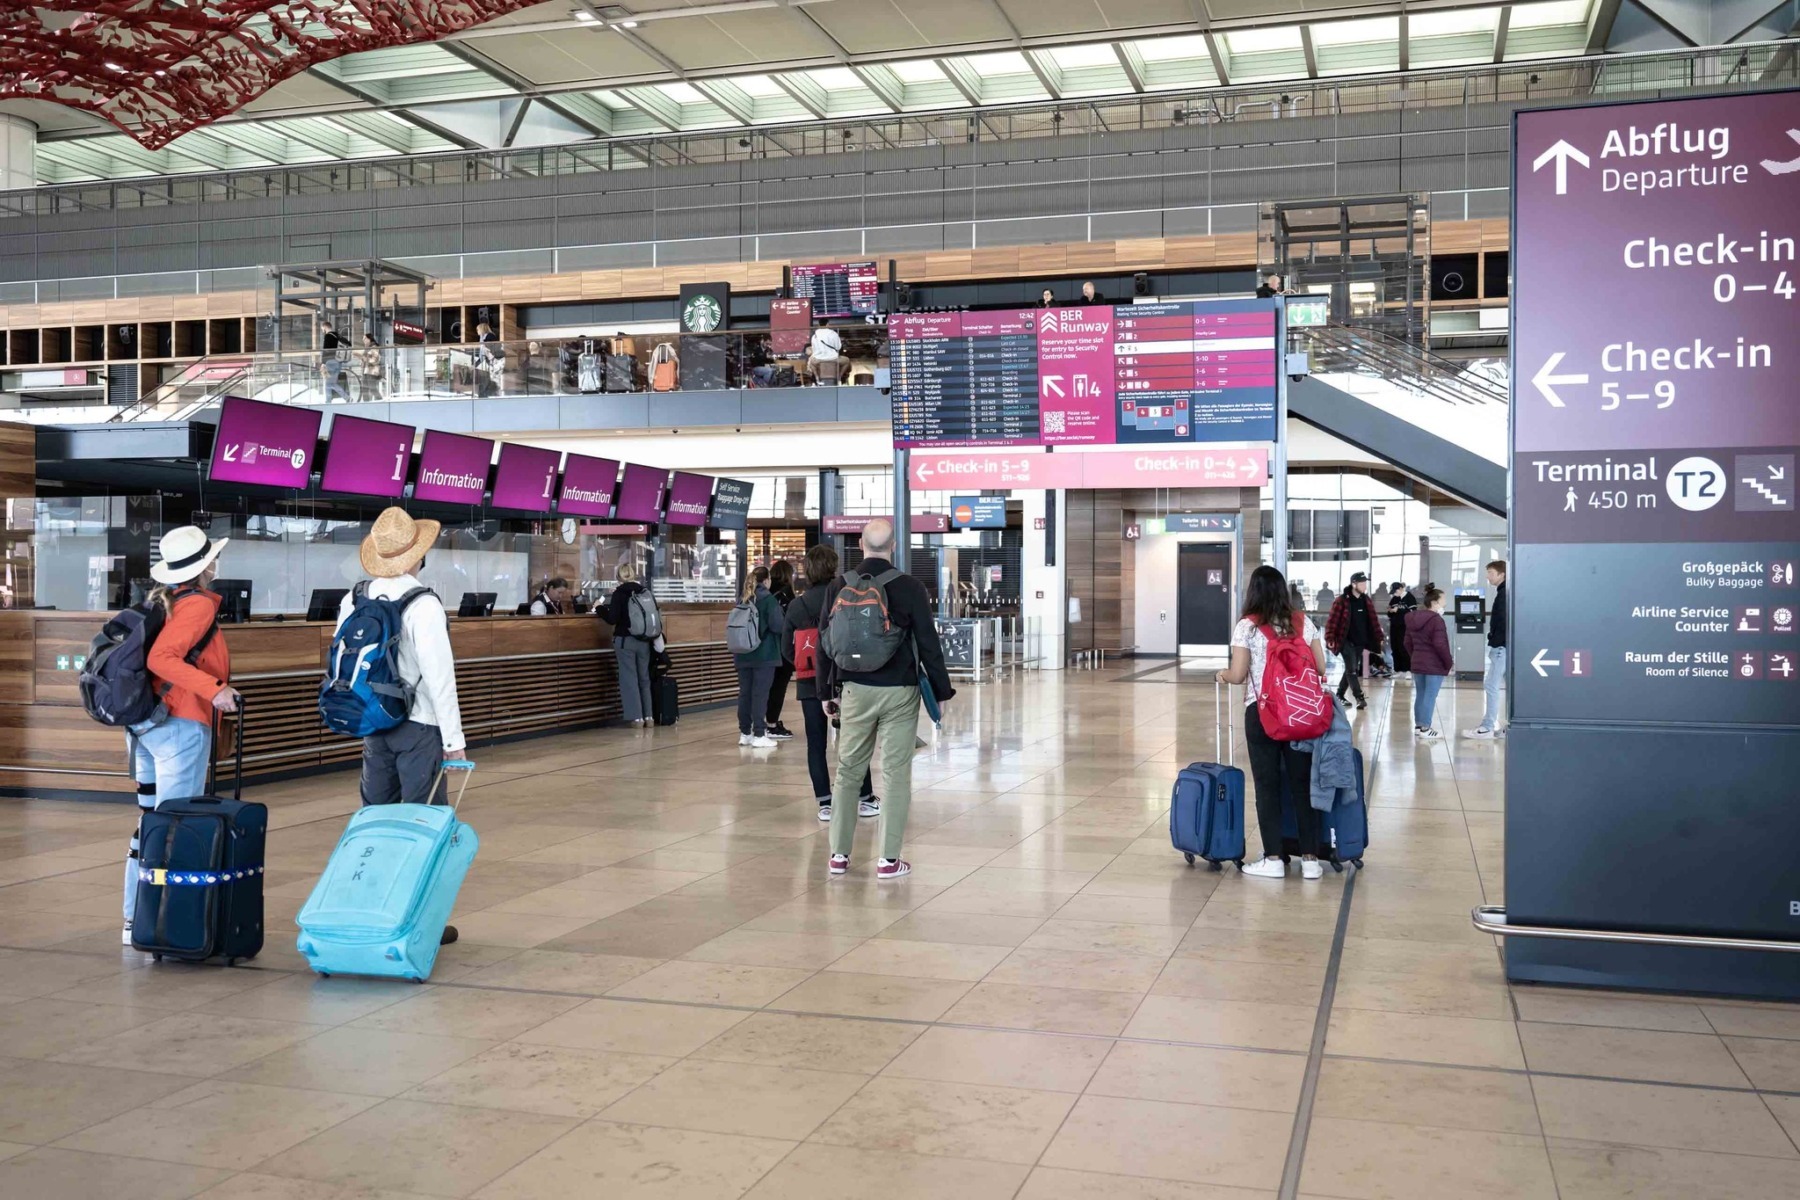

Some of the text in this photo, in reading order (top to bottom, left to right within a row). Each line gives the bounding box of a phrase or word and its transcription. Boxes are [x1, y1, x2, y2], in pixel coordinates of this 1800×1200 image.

[1600, 123, 1729, 160] Abflug
[1602, 164, 1748, 196] Departure
[1624, 231, 1795, 269] Check-in
[904, 317, 925, 325] Abflug
[1060, 310, 1082, 321] BER
[1060, 322, 1109, 334] Runway
[1601, 337, 1772, 372] Check-in
[1090, 381, 1101, 397] 4
[259, 445, 304, 465] Terminal T2
[391, 443, 406, 481] i
[937, 459, 998, 474] Check-in
[1134, 456, 1200, 471] Check-in
[421, 468, 484, 490] Information
[542, 466, 554, 498] i
[1532, 457, 1717, 498] Terminal T2
[562, 486, 611, 505] Information
[727, 484, 740, 493] Service
[670, 500, 708, 515] Information
[1587, 491, 1657, 509] 450 m
[937, 518, 945, 528] 3
[1682, 560, 1764, 575] Großgepäck
[1686, 577, 1764, 589] Bulky Baggage
[1632, 606, 1729, 618] Airline Service
[1675, 621, 1729, 633] Counter
[1625, 652, 1729, 664] Raum der Stille
[1645, 667, 1729, 677] Room of Silence
[360, 846, 374, 858] B
[352, 870, 365, 881] K
